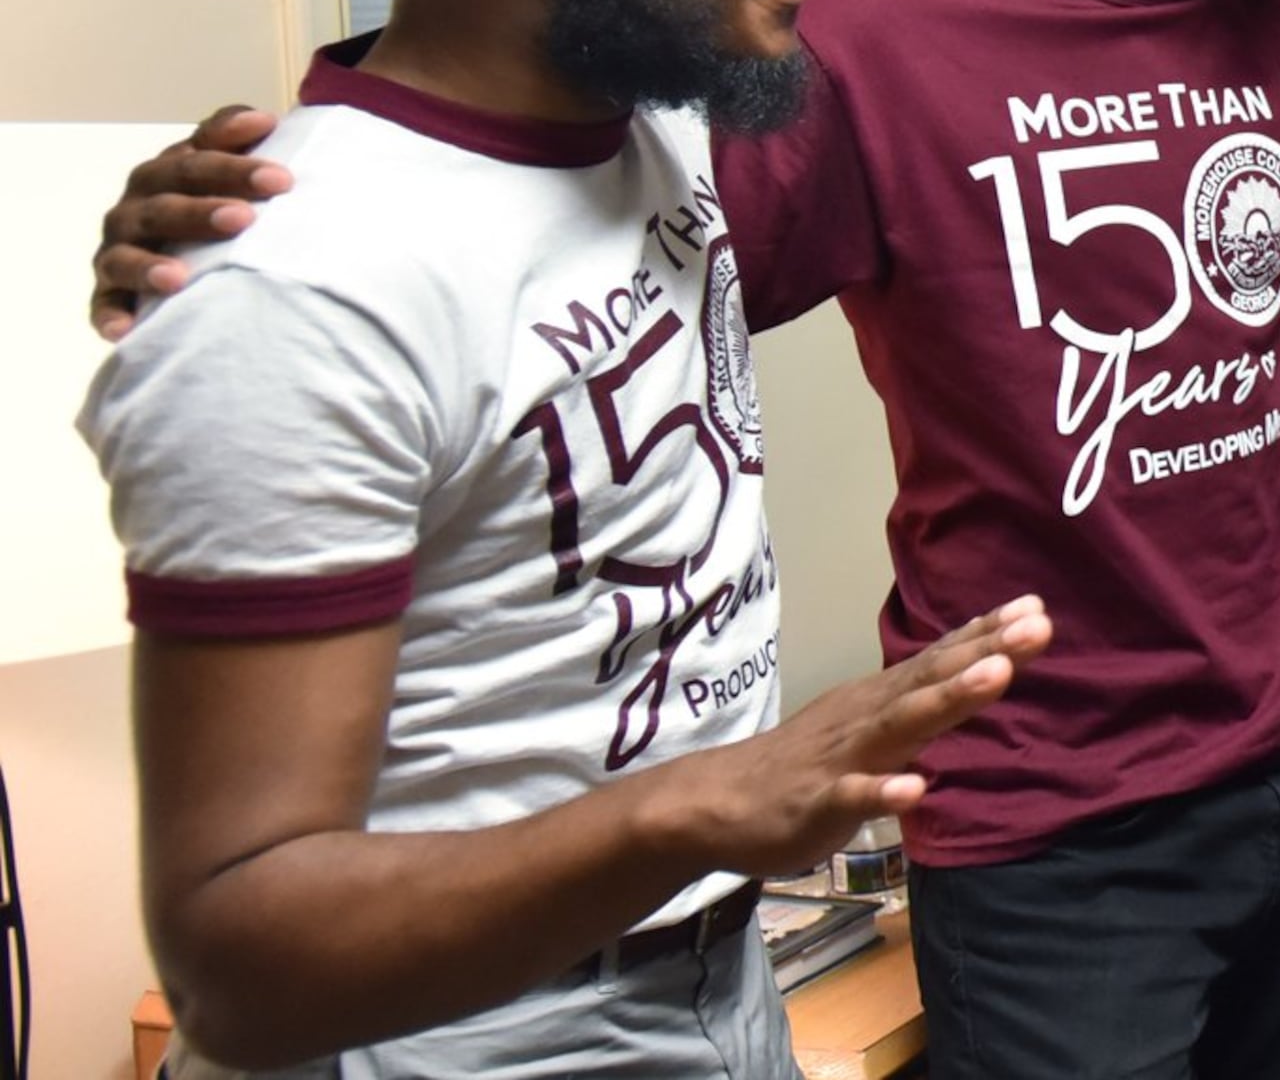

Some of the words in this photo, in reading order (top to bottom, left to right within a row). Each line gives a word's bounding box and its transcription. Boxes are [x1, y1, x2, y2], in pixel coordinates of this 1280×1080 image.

[1007, 92, 1158, 144] MORE
[1158, 83, 1273, 129] THAN
[1195, 148, 1254, 241] MOREHOUSE
[1129, 424, 1265, 485] DEVELOPING
[681, 628, 780, 719] PRODUC
